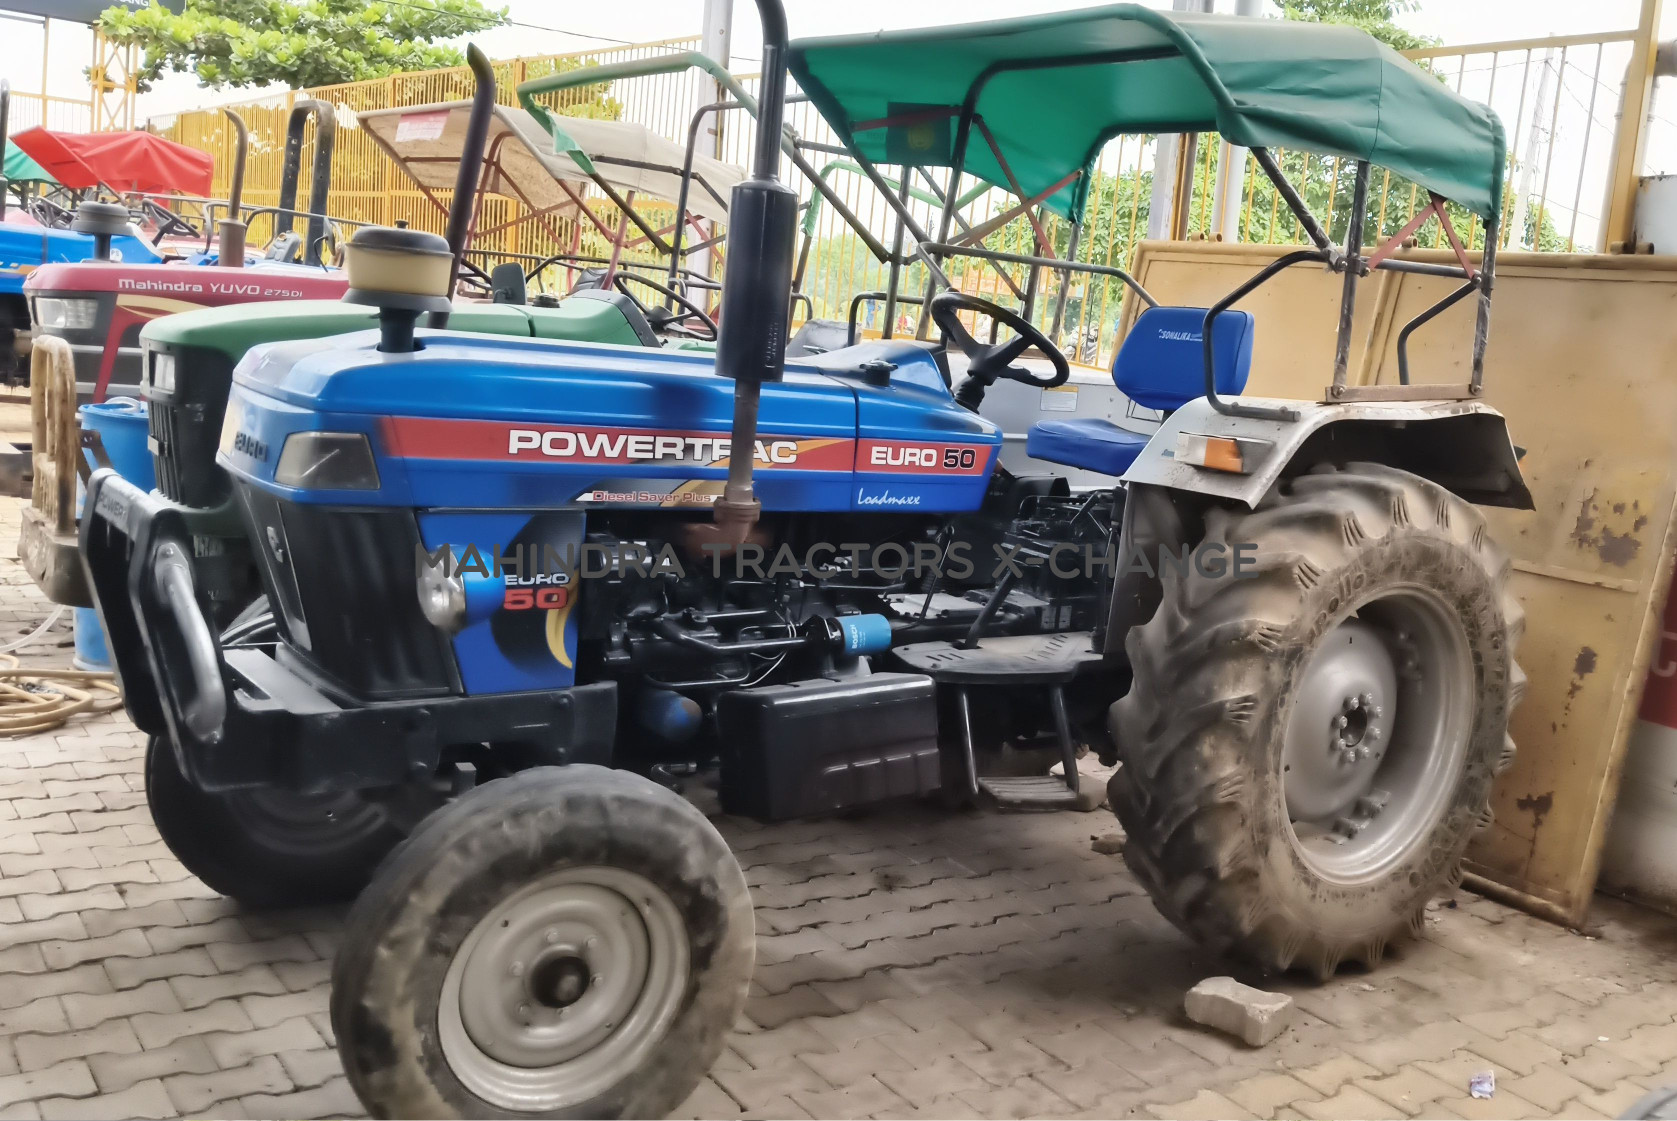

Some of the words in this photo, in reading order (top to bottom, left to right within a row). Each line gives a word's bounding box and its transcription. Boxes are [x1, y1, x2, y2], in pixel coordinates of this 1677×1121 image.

[118, 278, 203, 292] Mahindra
[209, 283, 260, 295] YUVO
[508, 430, 797, 464] POWERTRAC
[870, 446, 937, 467] EURO
[943, 448, 976, 470] 50
[592, 491, 636, 502] Diesel
[638, 491, 679, 503] Saver
[682, 492, 712, 503] Plus
[857, 487, 921, 505] Loadmaxx
[504, 573, 569, 585] EURO
[503, 587, 569, 610] 50
[850, 624, 859, 649] BOSCH
